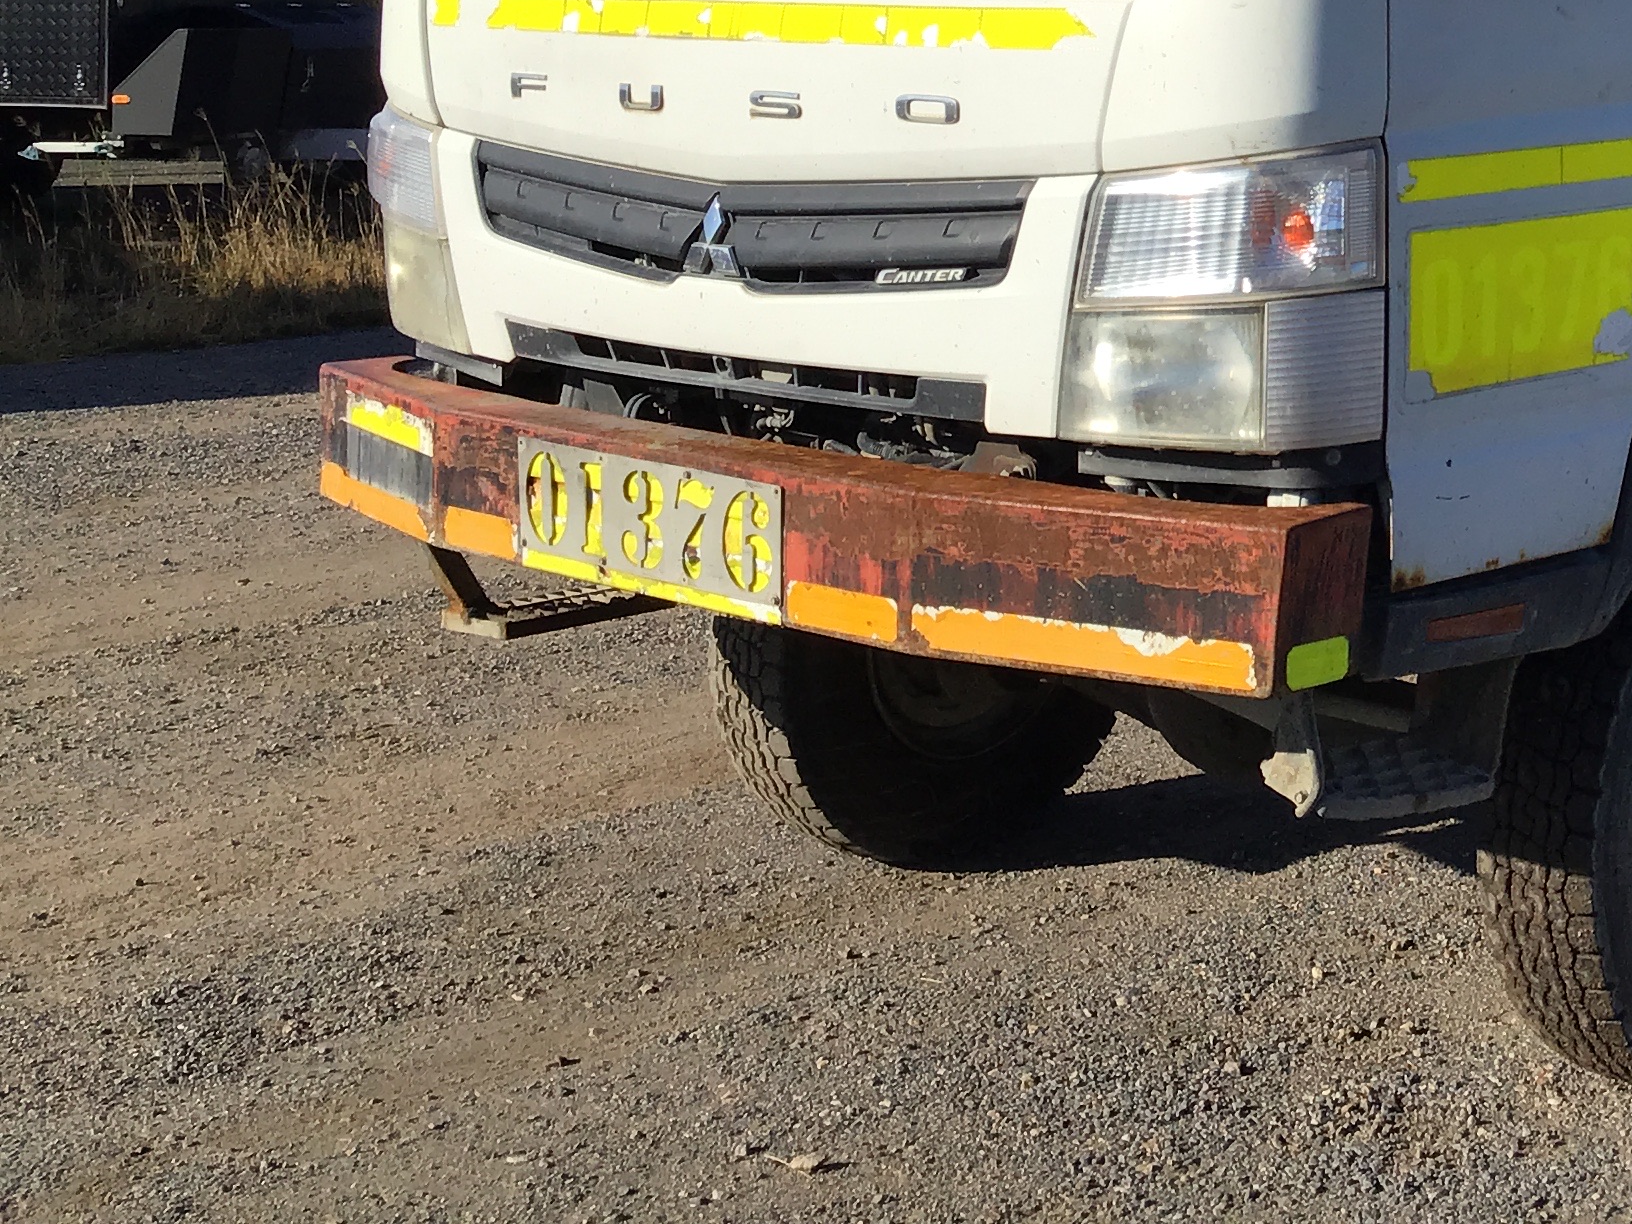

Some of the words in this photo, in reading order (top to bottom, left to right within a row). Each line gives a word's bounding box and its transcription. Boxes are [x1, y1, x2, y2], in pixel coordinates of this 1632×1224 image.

[509, 72, 962, 126] FUSO
[874, 267, 966, 285] CANTER
[526, 450, 774, 594] 01376
